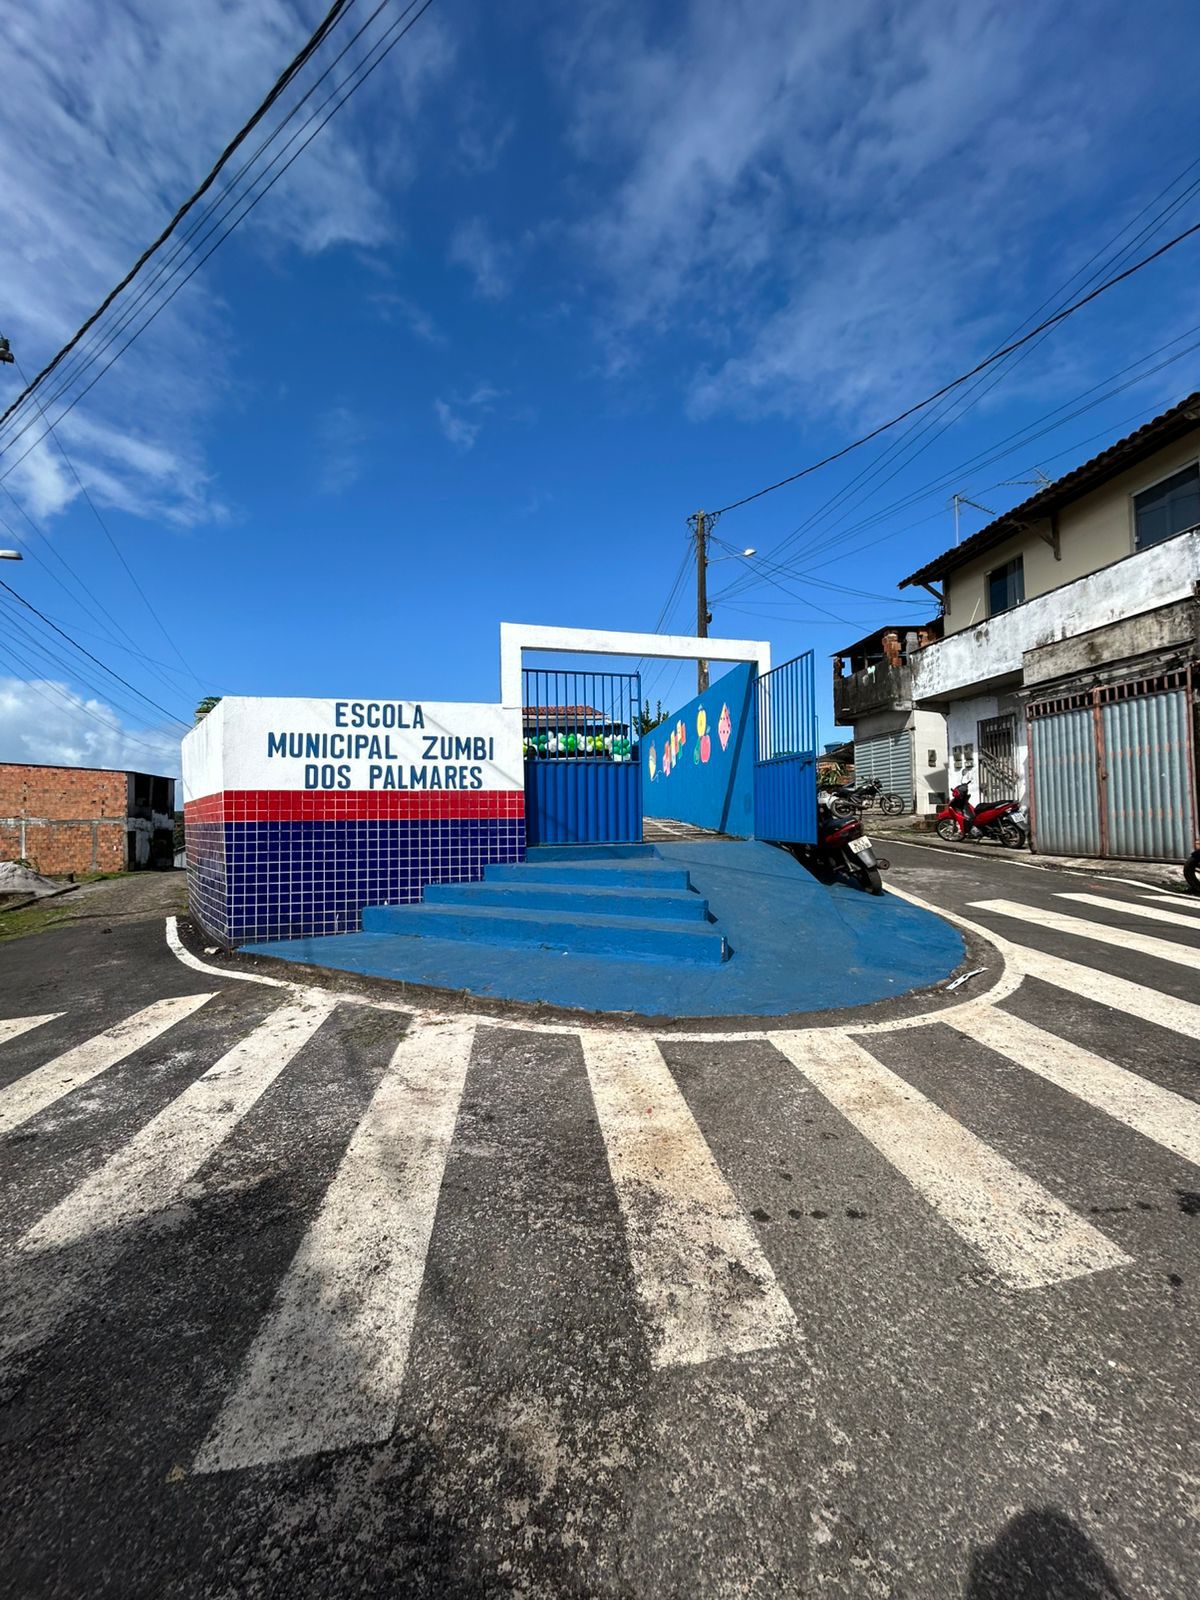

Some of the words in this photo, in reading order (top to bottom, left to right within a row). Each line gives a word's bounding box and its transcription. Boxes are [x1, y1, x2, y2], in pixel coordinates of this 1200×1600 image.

[335, 702, 425, 729] ESCOLA
[267, 732, 398, 760] MUNICIPAL
[422, 735, 494, 761] ZUMBI
[304, 764, 351, 789] DOS
[369, 764, 483, 790] PALMARES
